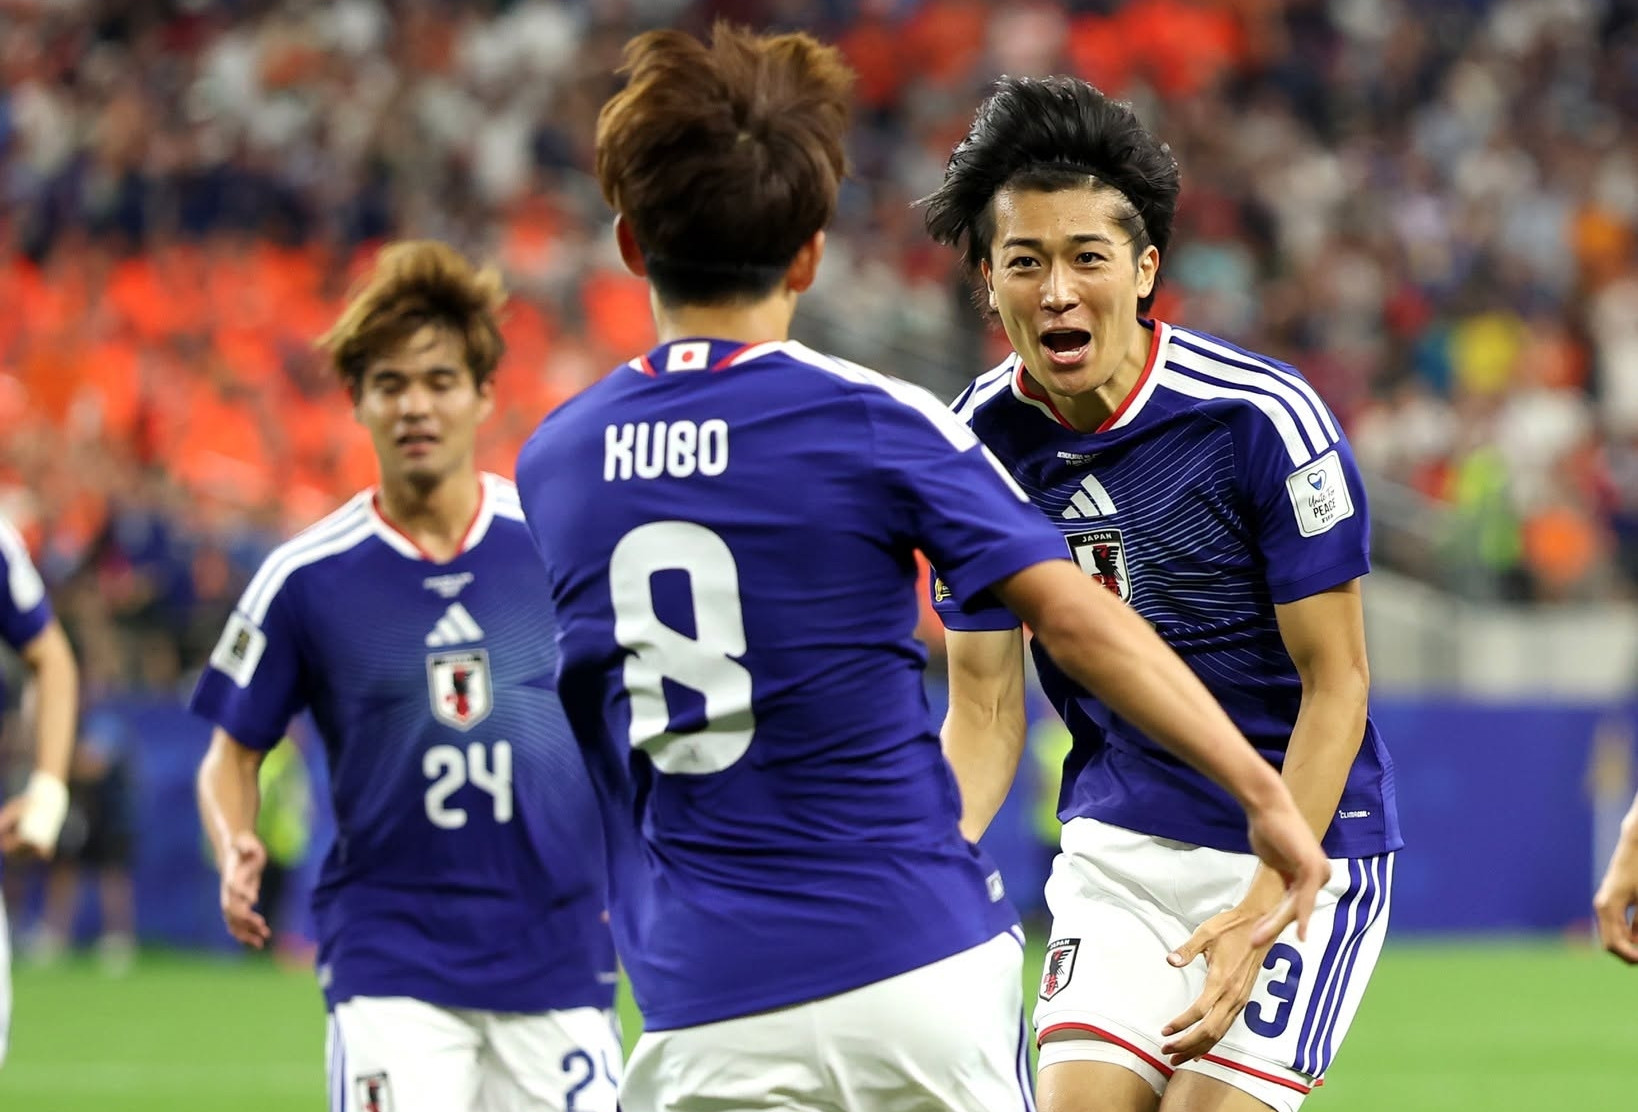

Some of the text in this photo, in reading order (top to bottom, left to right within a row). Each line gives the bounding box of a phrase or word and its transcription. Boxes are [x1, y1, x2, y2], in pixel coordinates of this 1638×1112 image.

[604, 419, 728, 481] KUBO
[1082, 532, 1112, 543] JAPAN
[1313, 497, 1336, 518] PEACE
[609, 520, 755, 774] 8
[422, 740, 513, 829] 24
[1050, 939, 1071, 949] JAPAN
[562, 1049, 618, 1112] 2
